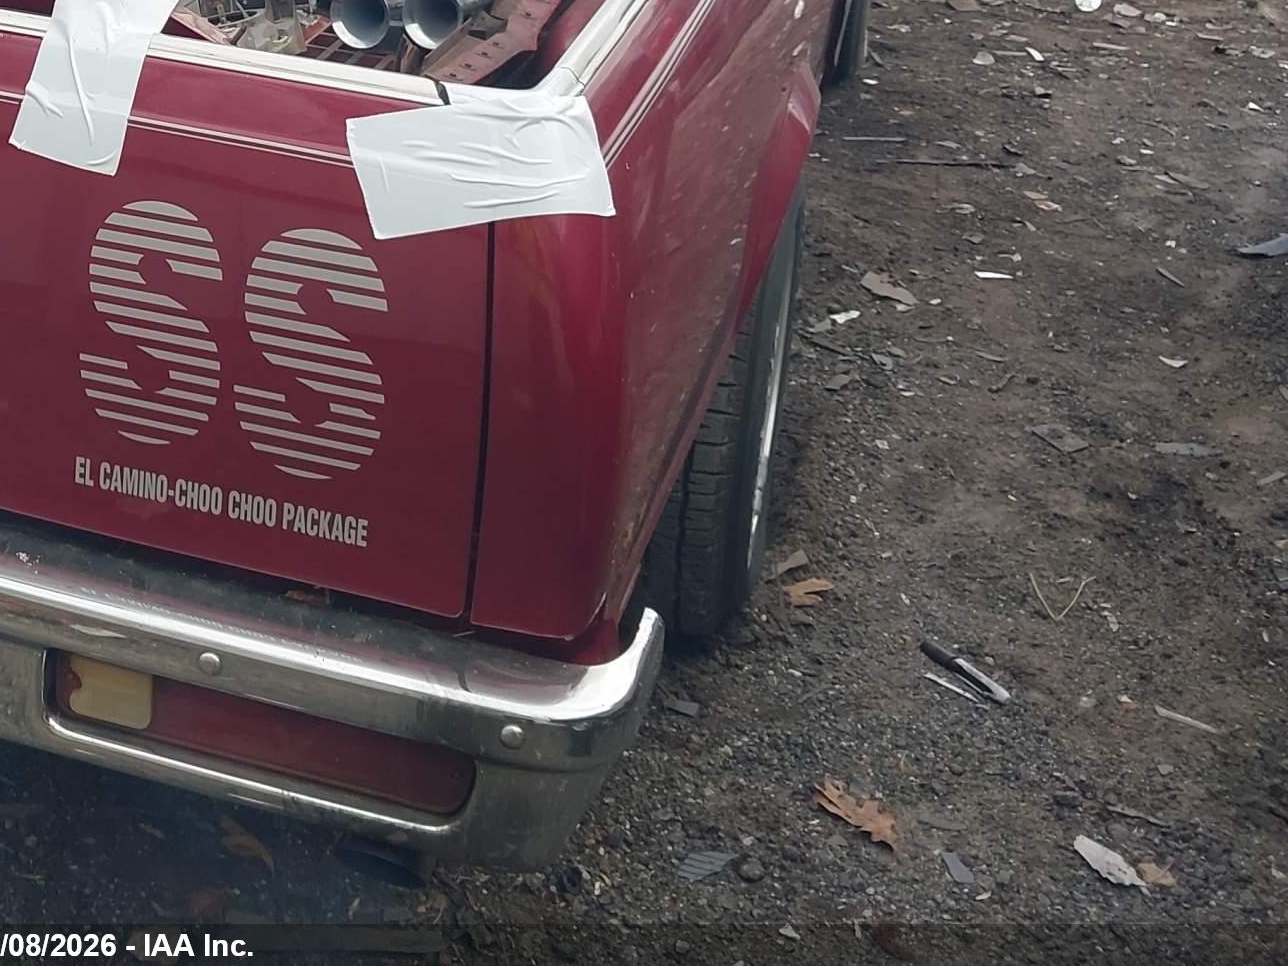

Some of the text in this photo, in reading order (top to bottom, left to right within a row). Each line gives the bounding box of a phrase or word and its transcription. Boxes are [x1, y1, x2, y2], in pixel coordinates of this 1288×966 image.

[79, 199, 389, 480] SS
[74, 456, 369, 547] EL CAMINO-CHOO CHOO PACKAGE
